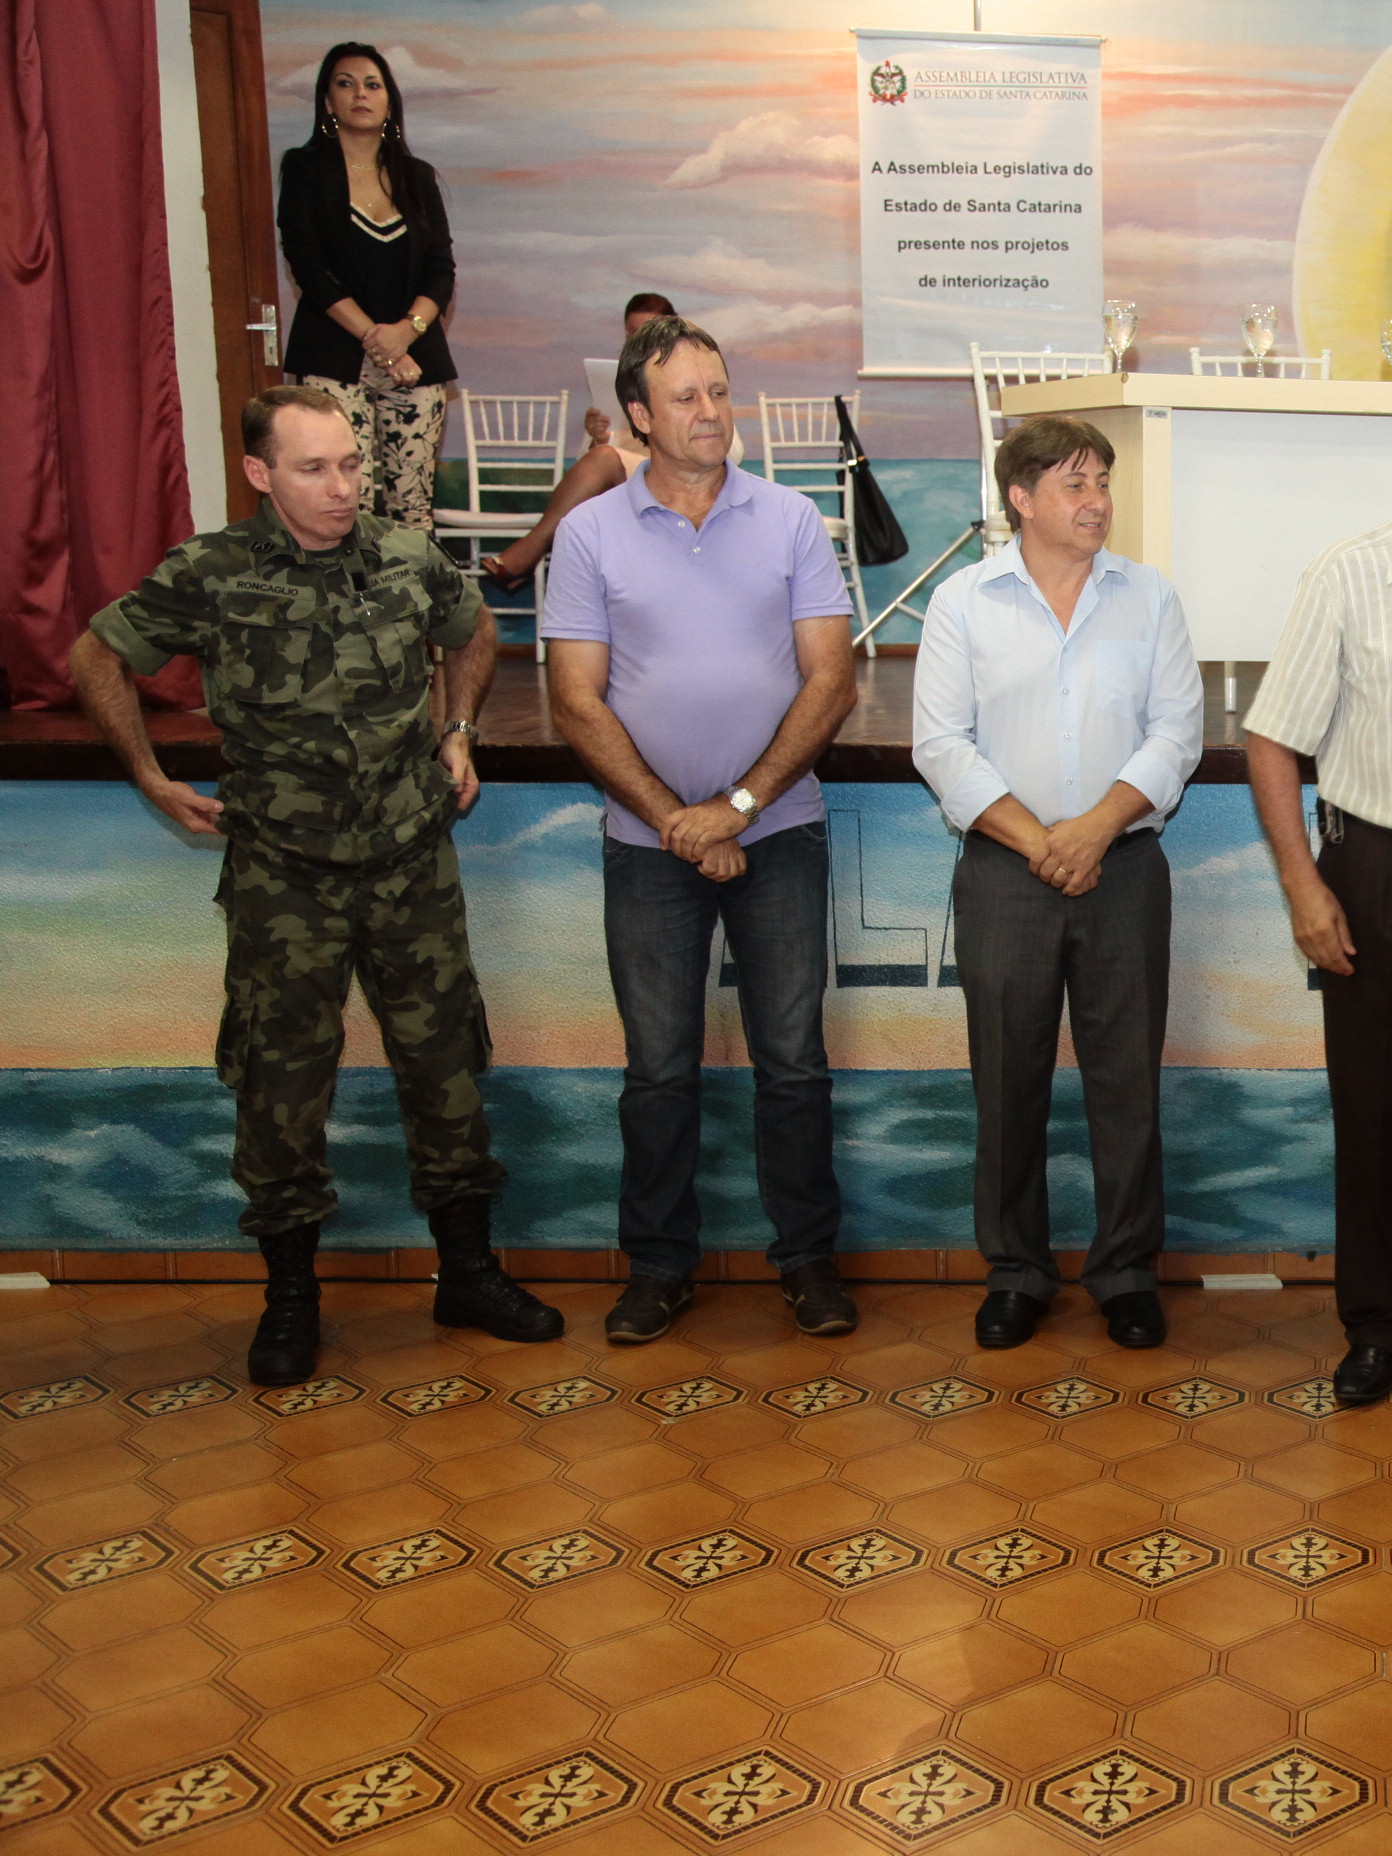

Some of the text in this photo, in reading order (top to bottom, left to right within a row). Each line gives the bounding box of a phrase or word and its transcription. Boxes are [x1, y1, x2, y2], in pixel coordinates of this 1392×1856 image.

[915, 71, 1087, 84] ASSEMBLEIA LEGISLATIVA
[914, 90, 1088, 100] DO ESTADO DE SANTA CATARINA
[872, 161, 1093, 177] A Assembleia Legislativa do
[884, 199, 1081, 213] Estado de Santa Catarina
[898, 238, 1069, 253] presente nos projetos
[919, 275, 1049, 291] de interiorização
[381, 569, 409, 583] MILITAR
[236, 581, 298, 596] RONCAGLIO
